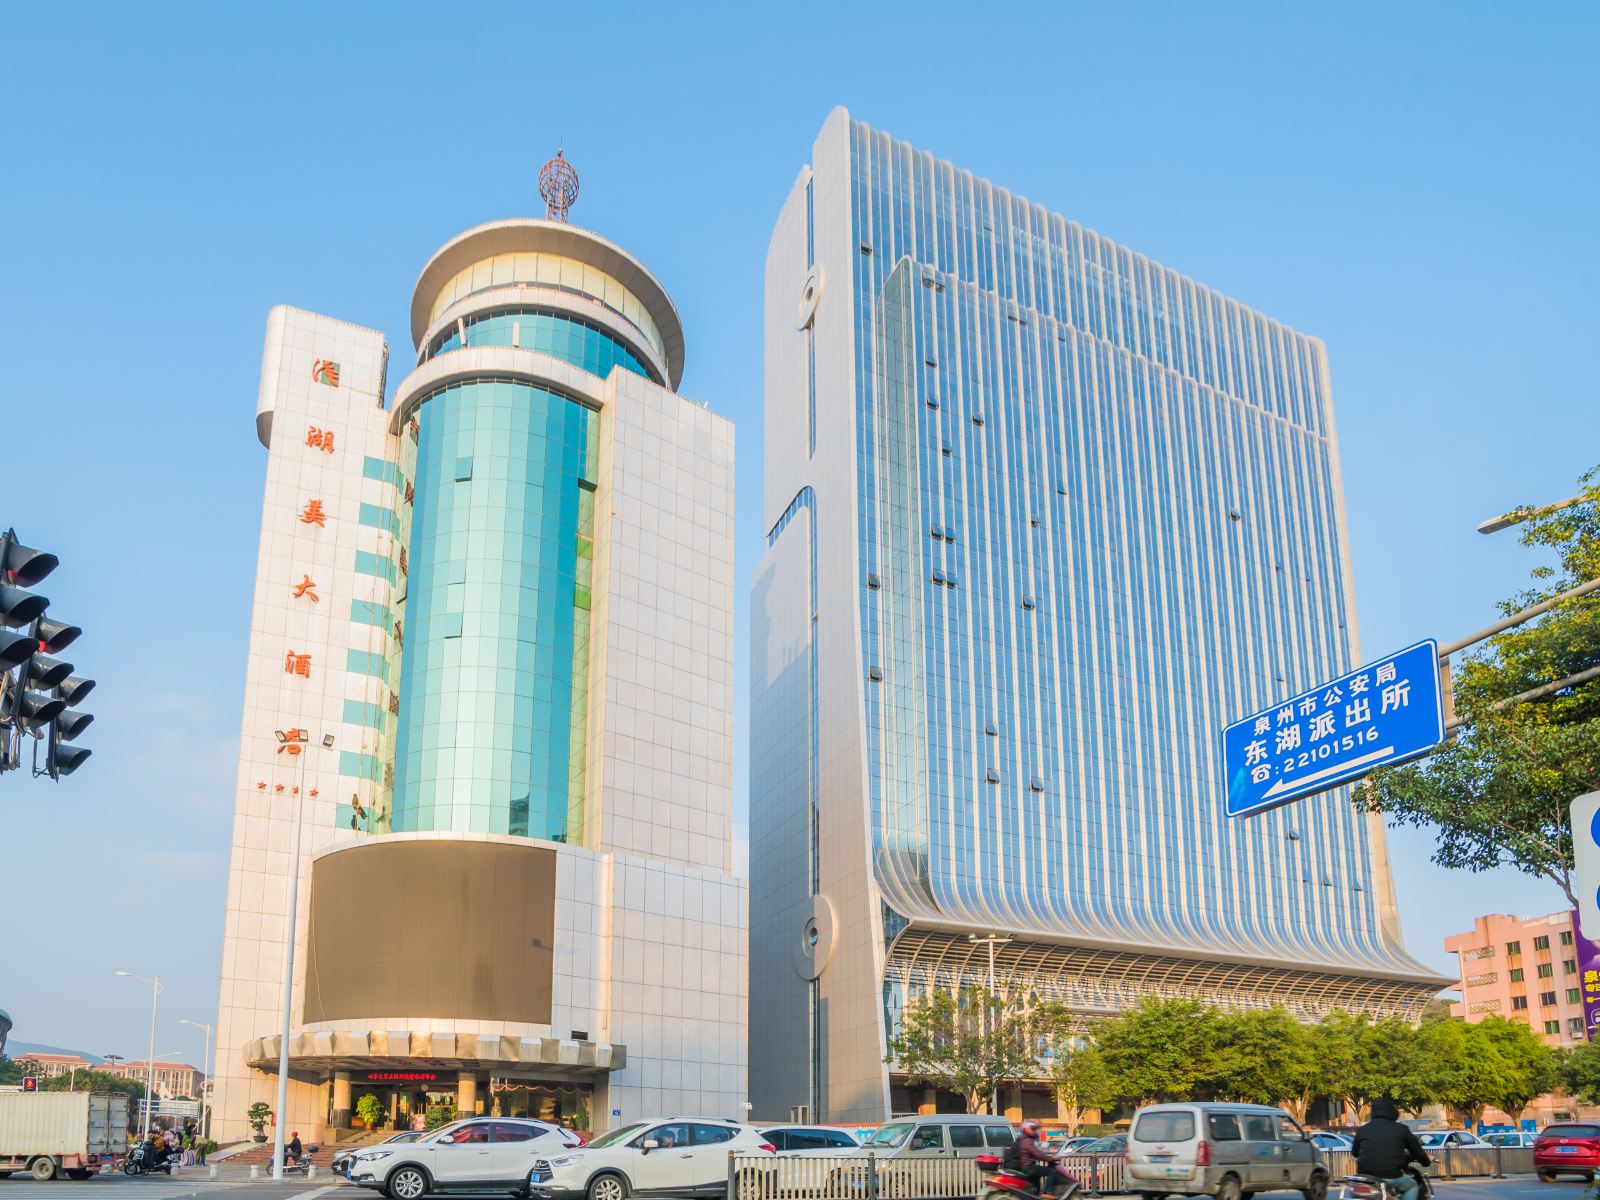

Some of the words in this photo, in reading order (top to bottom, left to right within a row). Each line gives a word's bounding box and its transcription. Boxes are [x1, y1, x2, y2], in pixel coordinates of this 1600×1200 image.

[1244, 679, 1411, 767] 东湖派出所
[1254, 661, 1397, 737] 泉州市公安局
